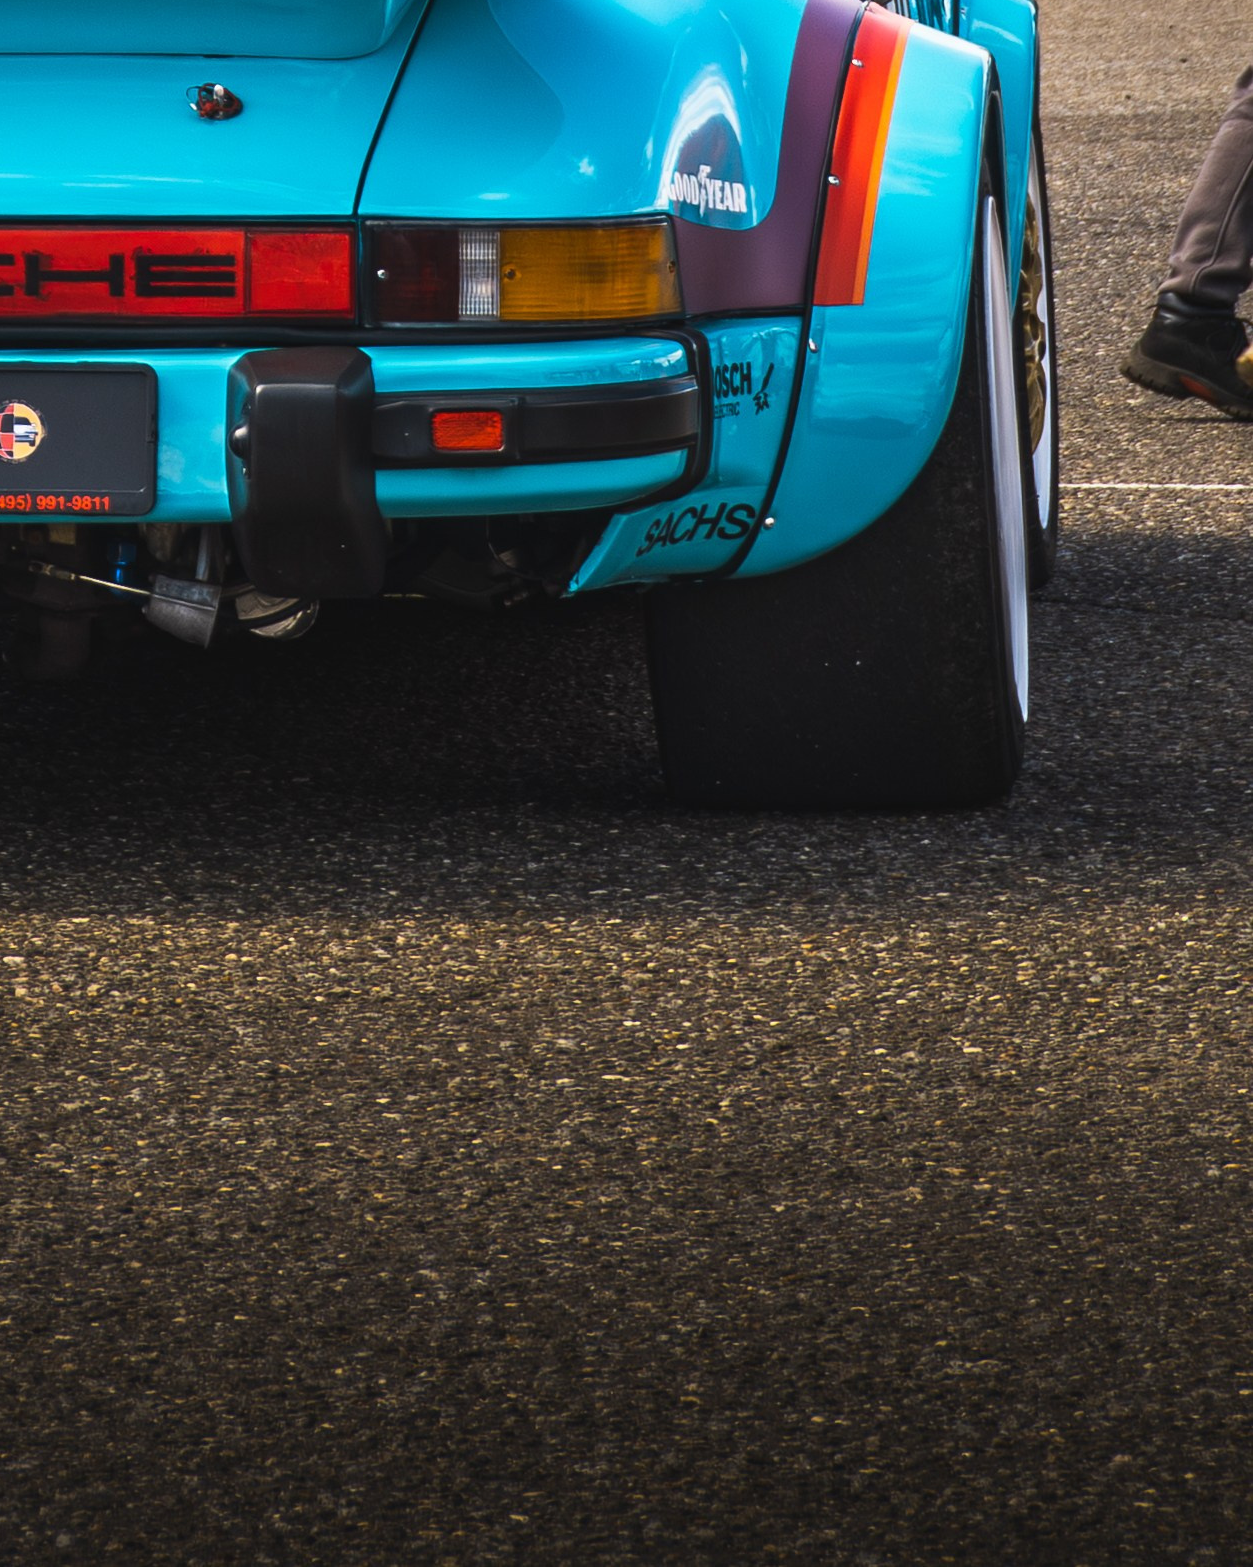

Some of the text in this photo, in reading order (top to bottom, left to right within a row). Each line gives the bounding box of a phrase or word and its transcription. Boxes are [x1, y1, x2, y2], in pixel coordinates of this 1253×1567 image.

[713, 360, 753, 400] OSCH
[36, 494, 111, 511] 991-9811
[635, 502, 757, 557] SACHS
